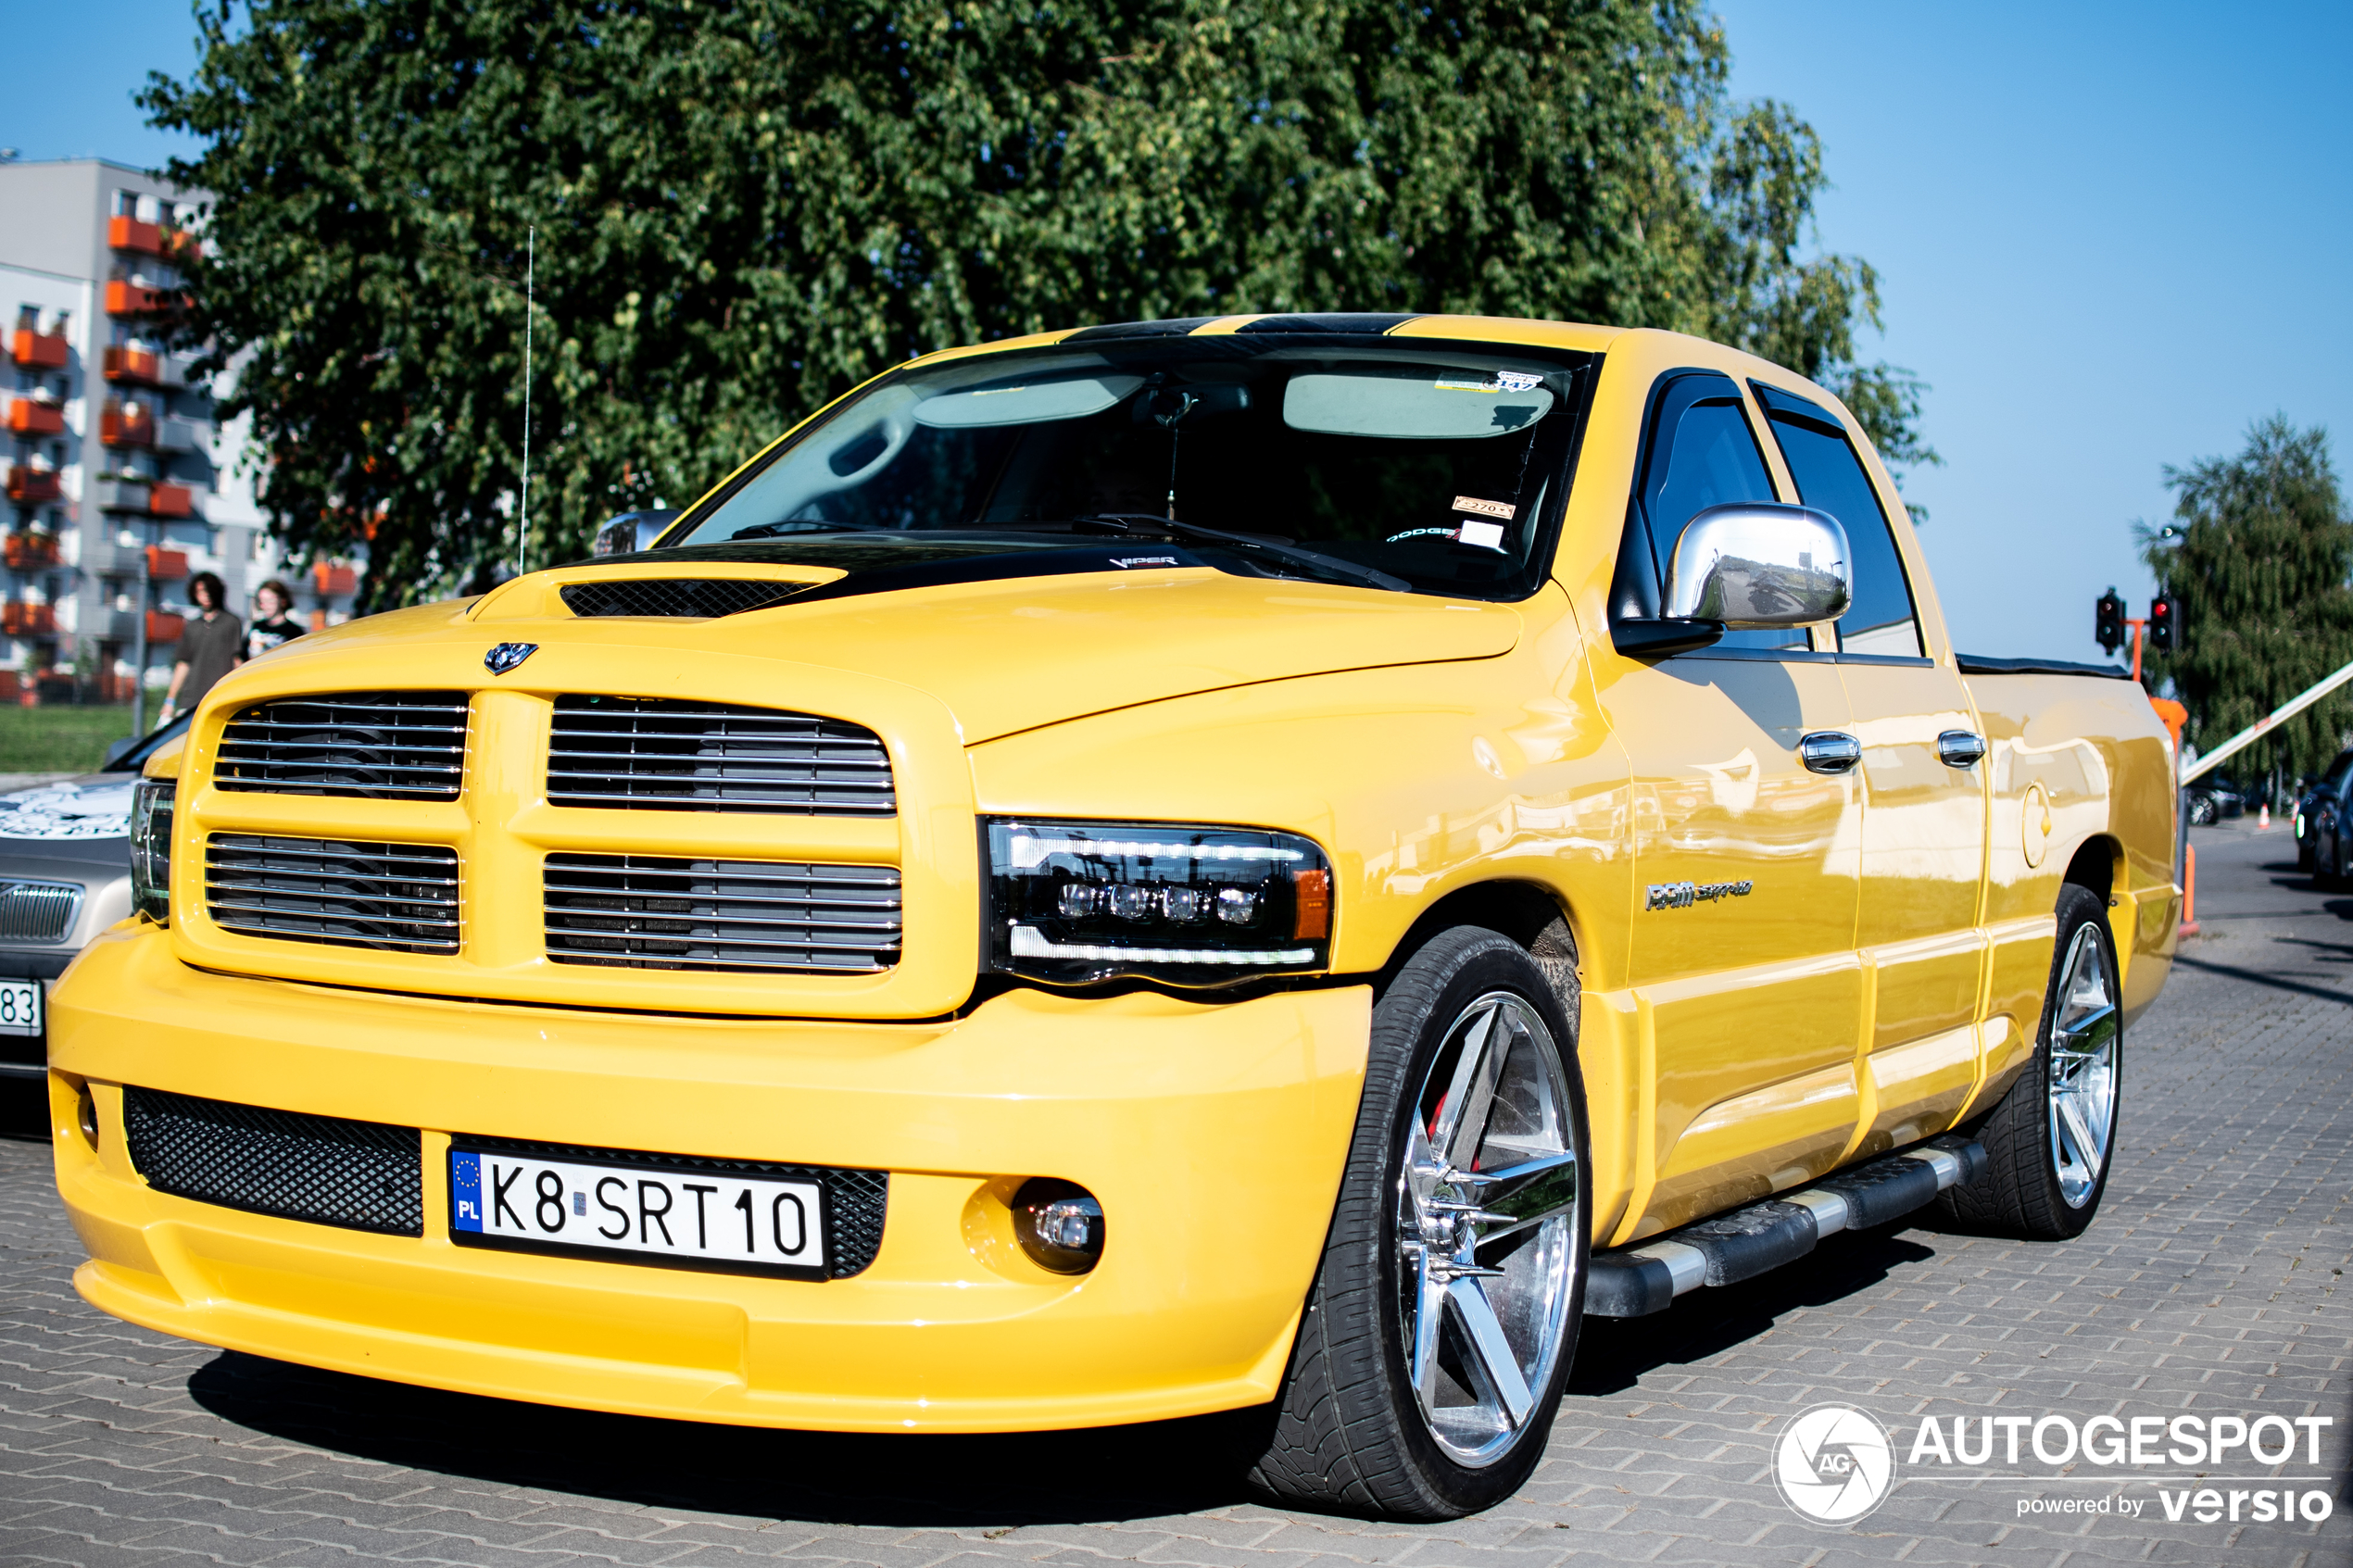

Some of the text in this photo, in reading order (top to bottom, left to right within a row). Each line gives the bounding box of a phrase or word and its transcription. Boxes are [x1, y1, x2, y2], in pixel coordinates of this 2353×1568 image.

[1109, 556, 1178, 569] VIPER
[458, 1200, 480, 1221] PL
[491, 1163, 807, 1257] K8 SRT10
